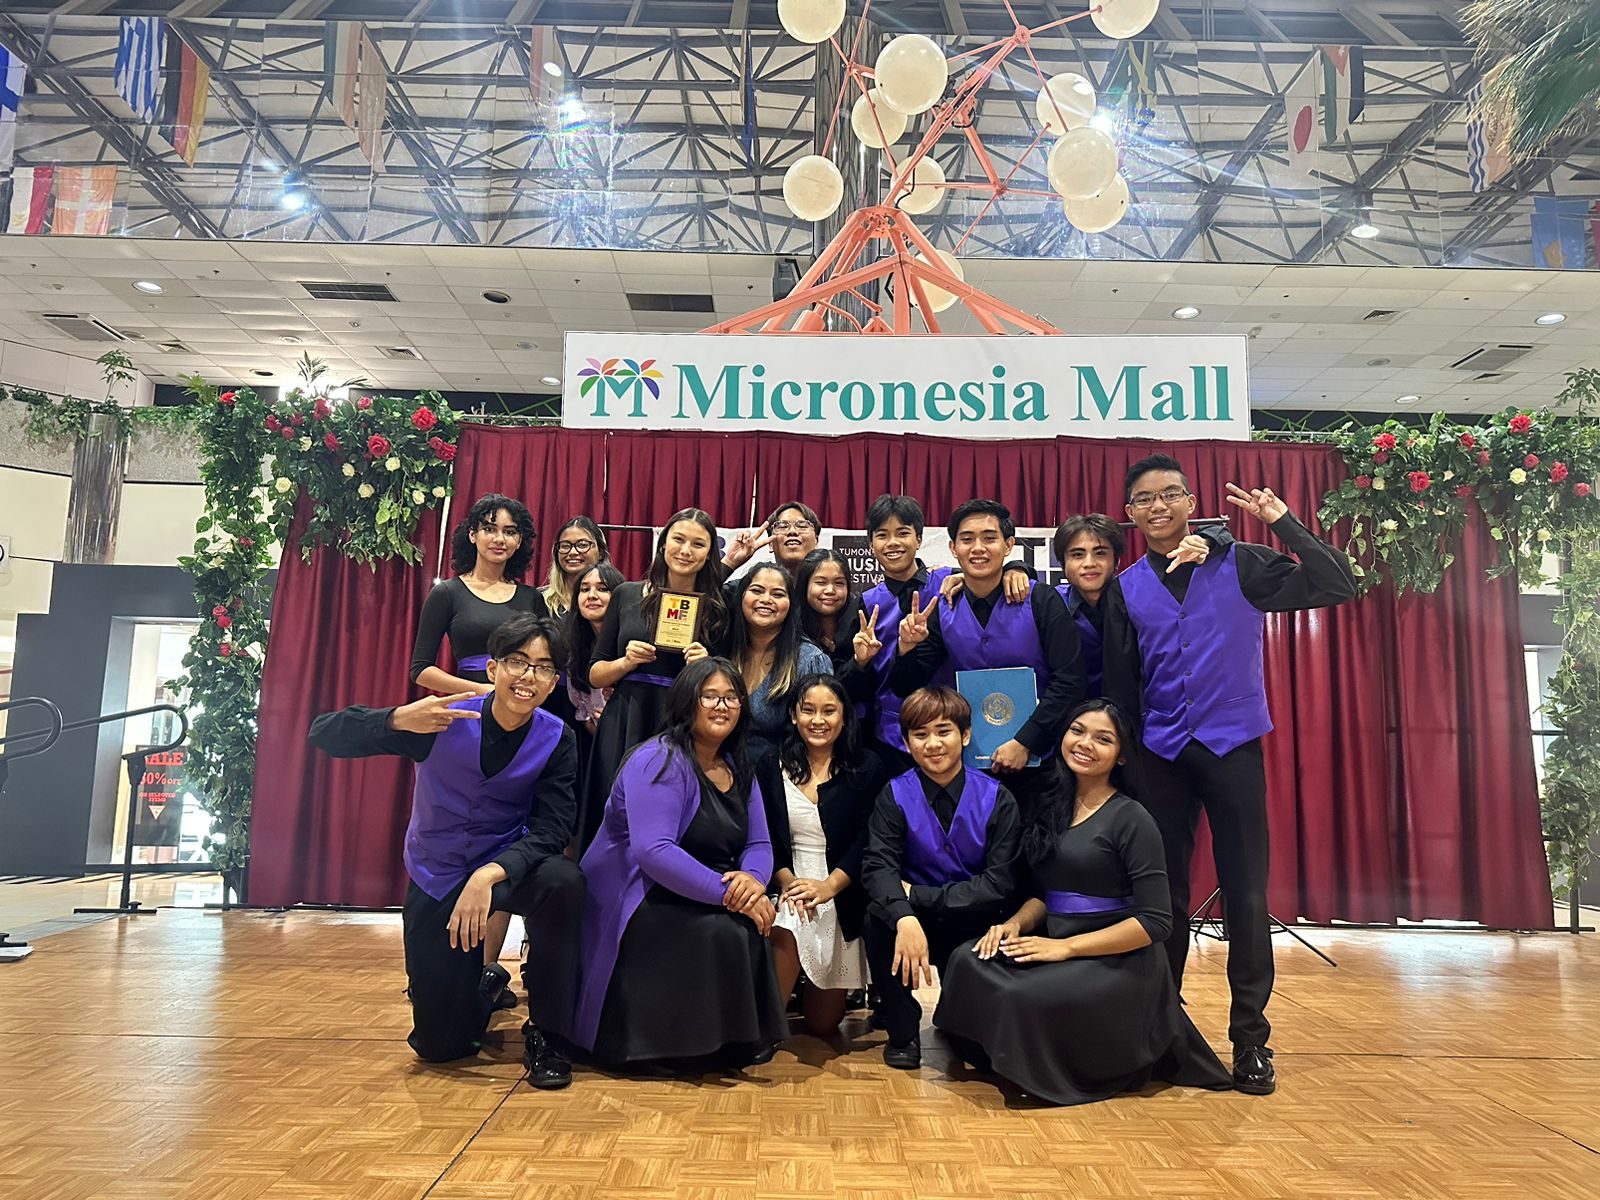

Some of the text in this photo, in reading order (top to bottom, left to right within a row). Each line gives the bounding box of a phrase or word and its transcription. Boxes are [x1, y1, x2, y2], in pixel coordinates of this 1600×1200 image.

[671, 364, 1235, 421] Micronesia Mall
[839, 547, 872, 556] TUMON
[847, 557, 885, 572] USI
